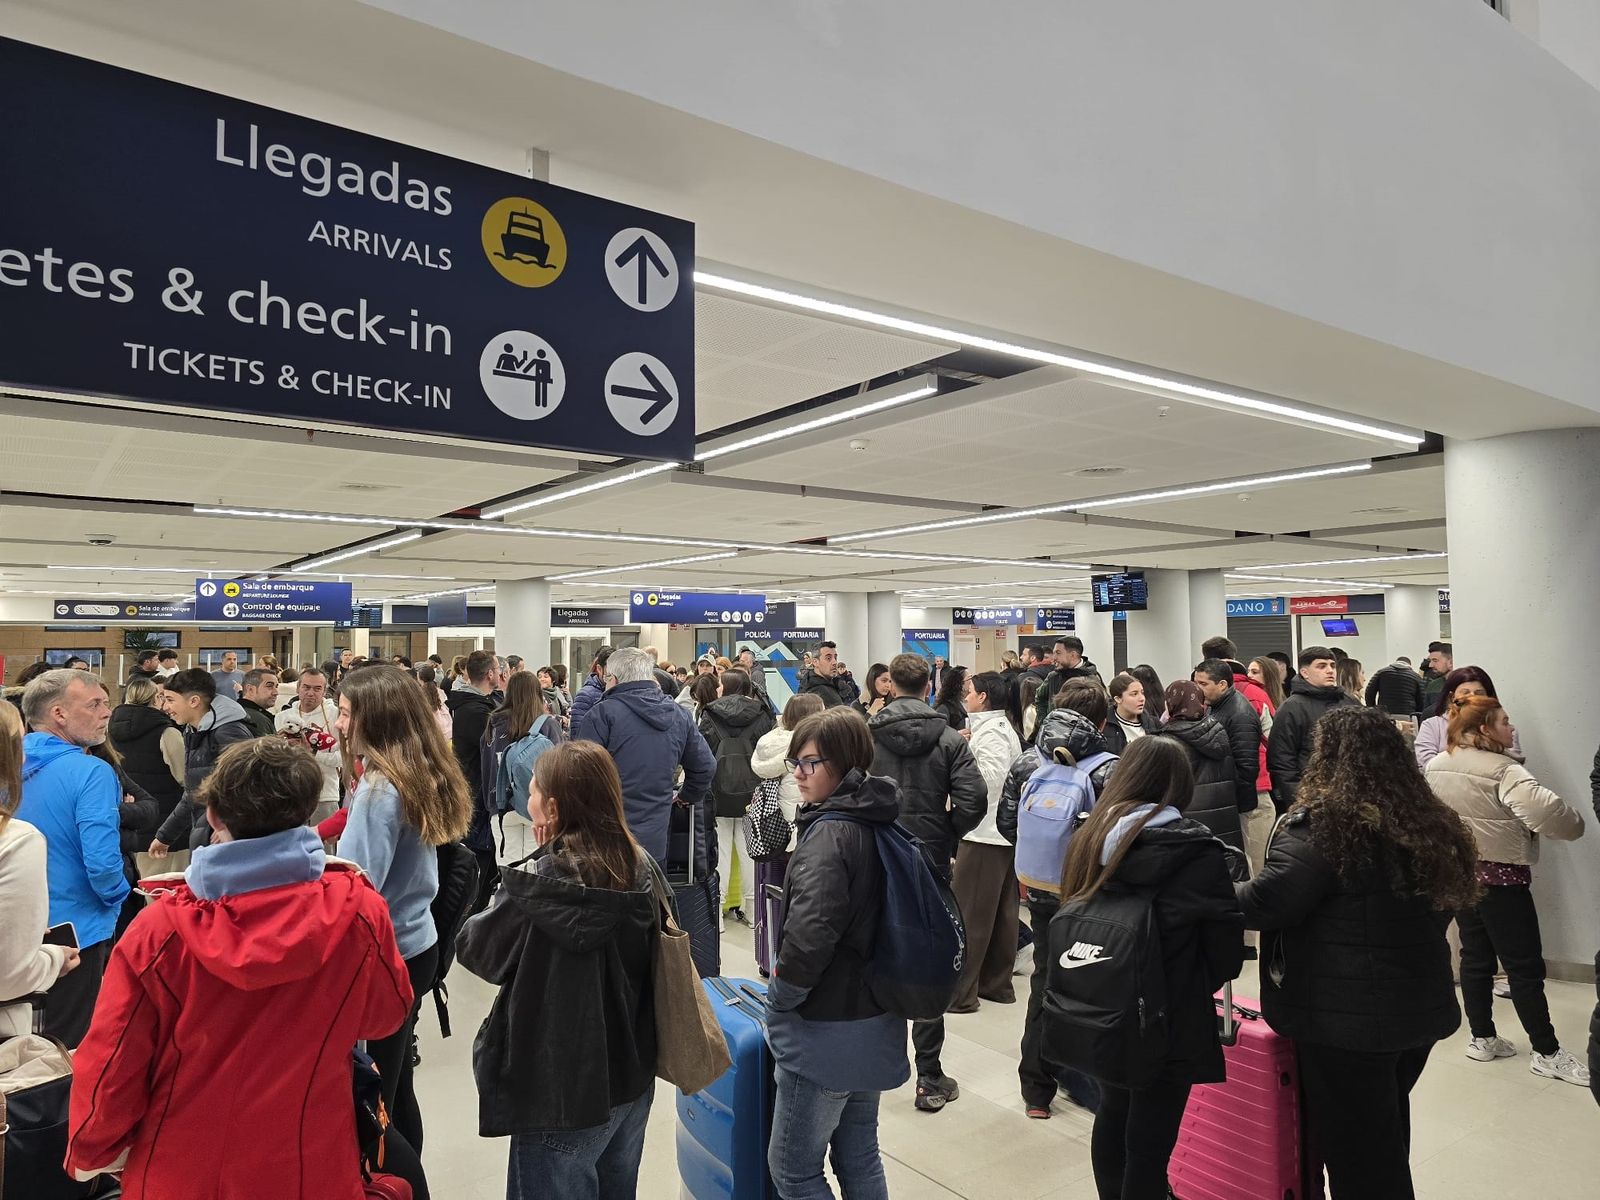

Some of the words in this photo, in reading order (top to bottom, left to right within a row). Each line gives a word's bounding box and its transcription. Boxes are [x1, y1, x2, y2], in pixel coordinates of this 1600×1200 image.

[215, 117, 452, 216] Llegadas
[308, 221, 452, 271] ARRIVALS
[0, 248, 134, 303] etes
[162, 268, 205, 316] &
[229, 280, 452, 356] check-in
[124, 343, 265, 385] TICKETS
[278, 365, 300, 391] &
[312, 370, 452, 410] CHECK-IN
[274, 583, 314, 592] embarque
[287, 603, 320, 612] equipaje
[557, 609, 588, 617] Llegadas
[1227, 602, 1264, 613] DANO
[744, 630, 771, 638] POLICÍA
[1069, 941, 1104, 960] NIKE
